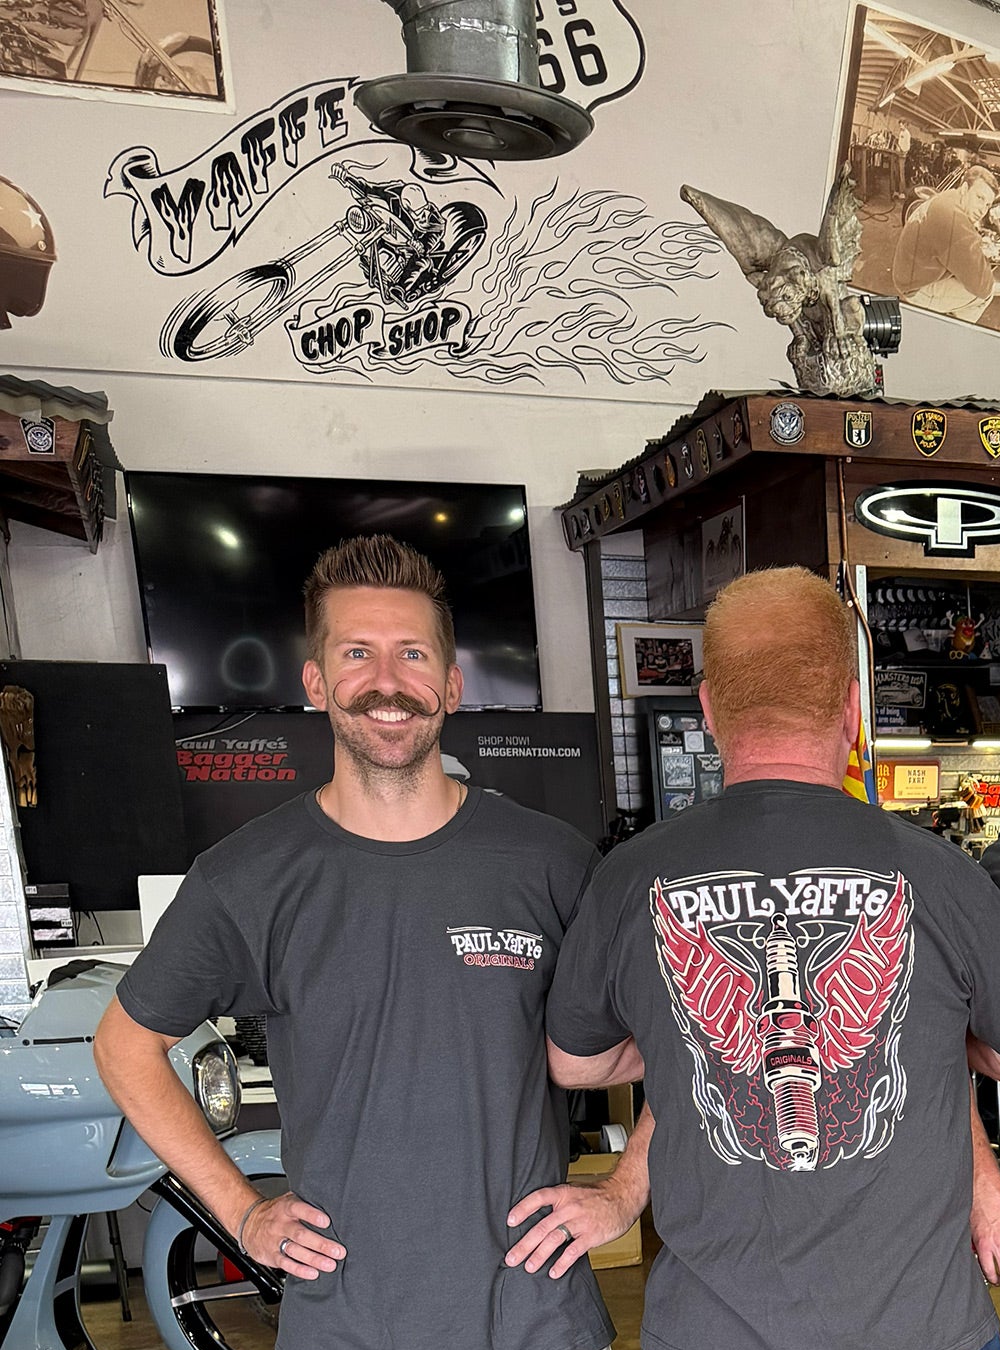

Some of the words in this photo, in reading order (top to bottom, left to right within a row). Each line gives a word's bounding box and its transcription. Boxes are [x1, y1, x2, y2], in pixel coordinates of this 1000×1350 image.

[536, 18, 608, 94] 66
[302, 307, 373, 361] CHOP
[388, 305, 460, 356] SHOP
[176, 739, 216, 750] aul
[221, 737, 288, 751] Yaffe's
[478, 736, 504, 746] SHOP
[505, 736, 530, 746] NOW!
[176, 750, 288, 769] Bagger
[479, 747, 581, 758] BAGGERNATION.COM
[185, 765, 297, 781] Nation
[670, 881, 776, 930] PAUL
[450, 932, 500, 955] PAUL
[463, 953, 535, 970] ORIGINALS
[667, 914, 760, 1068] PHOENIX
[820, 924, 901, 1057] ARIZONA
[769, 1055, 814, 1067] ORIGINALS
